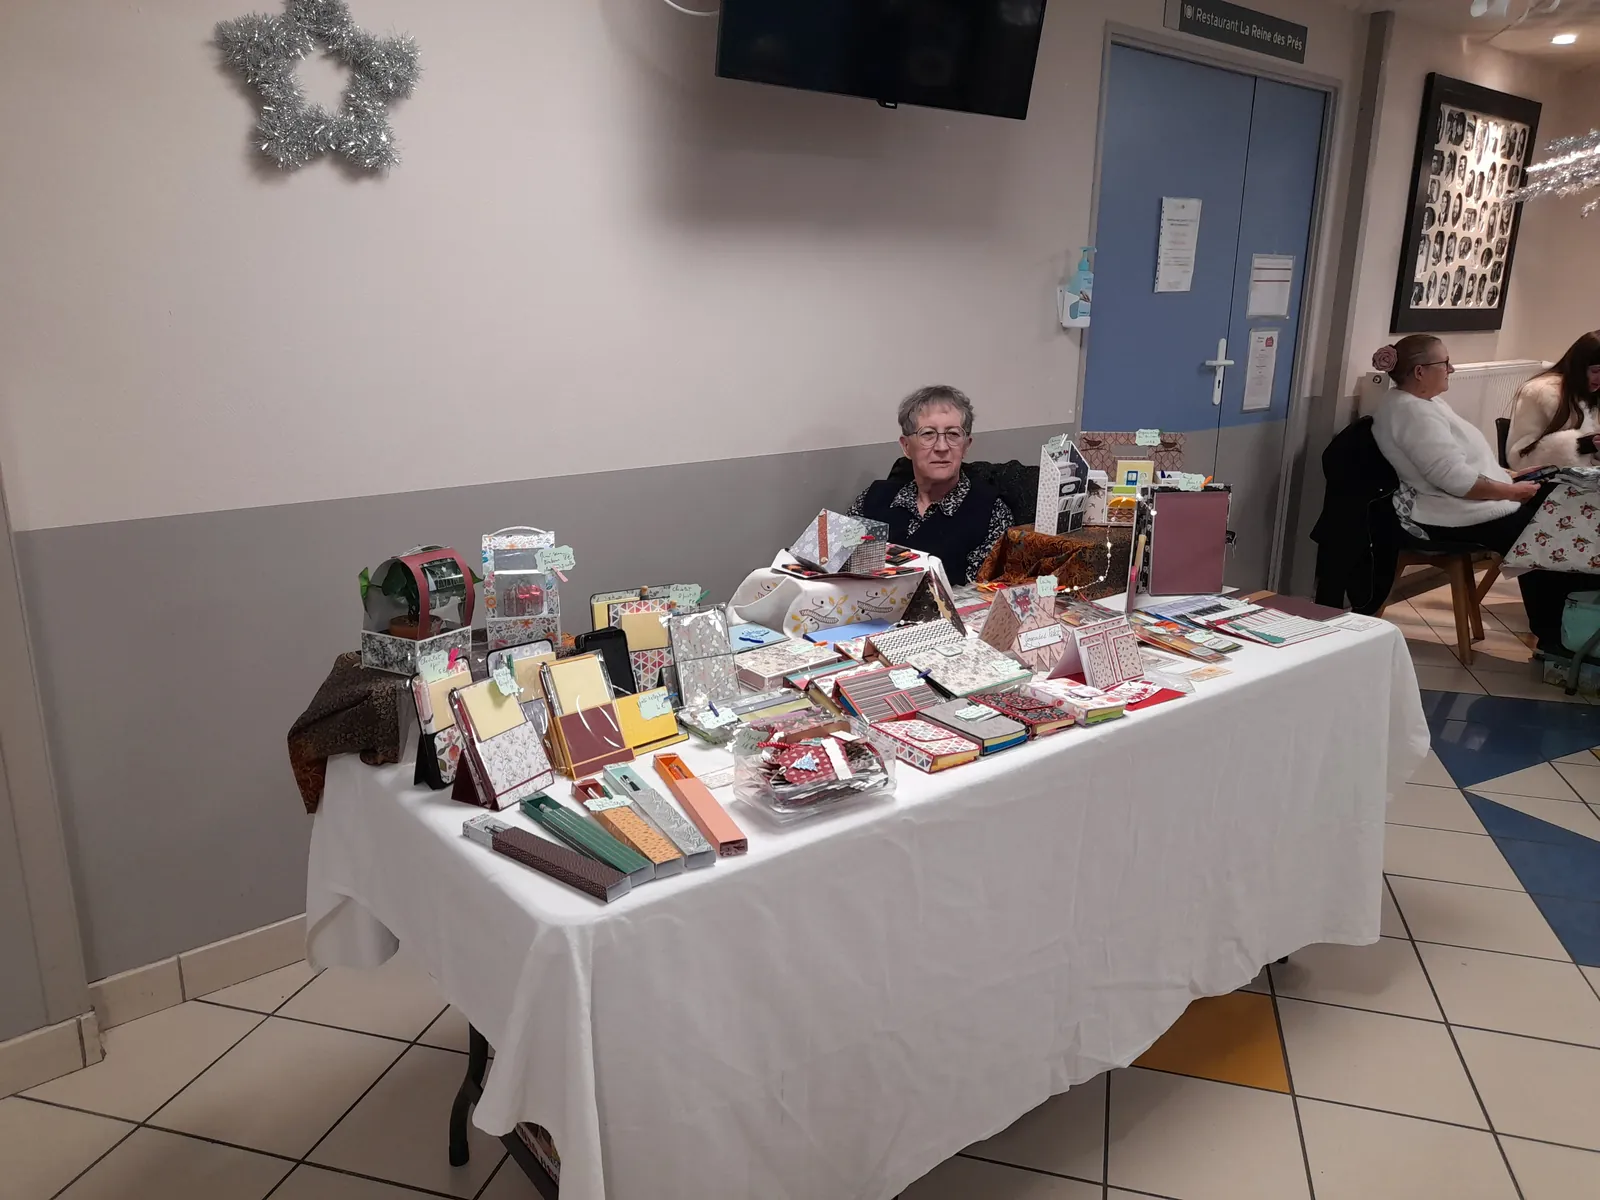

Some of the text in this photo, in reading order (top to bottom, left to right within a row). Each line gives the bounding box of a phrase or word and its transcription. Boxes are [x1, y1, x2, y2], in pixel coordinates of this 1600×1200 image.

[1196, 8, 1303, 51] Restaurant La Reine des Prés
